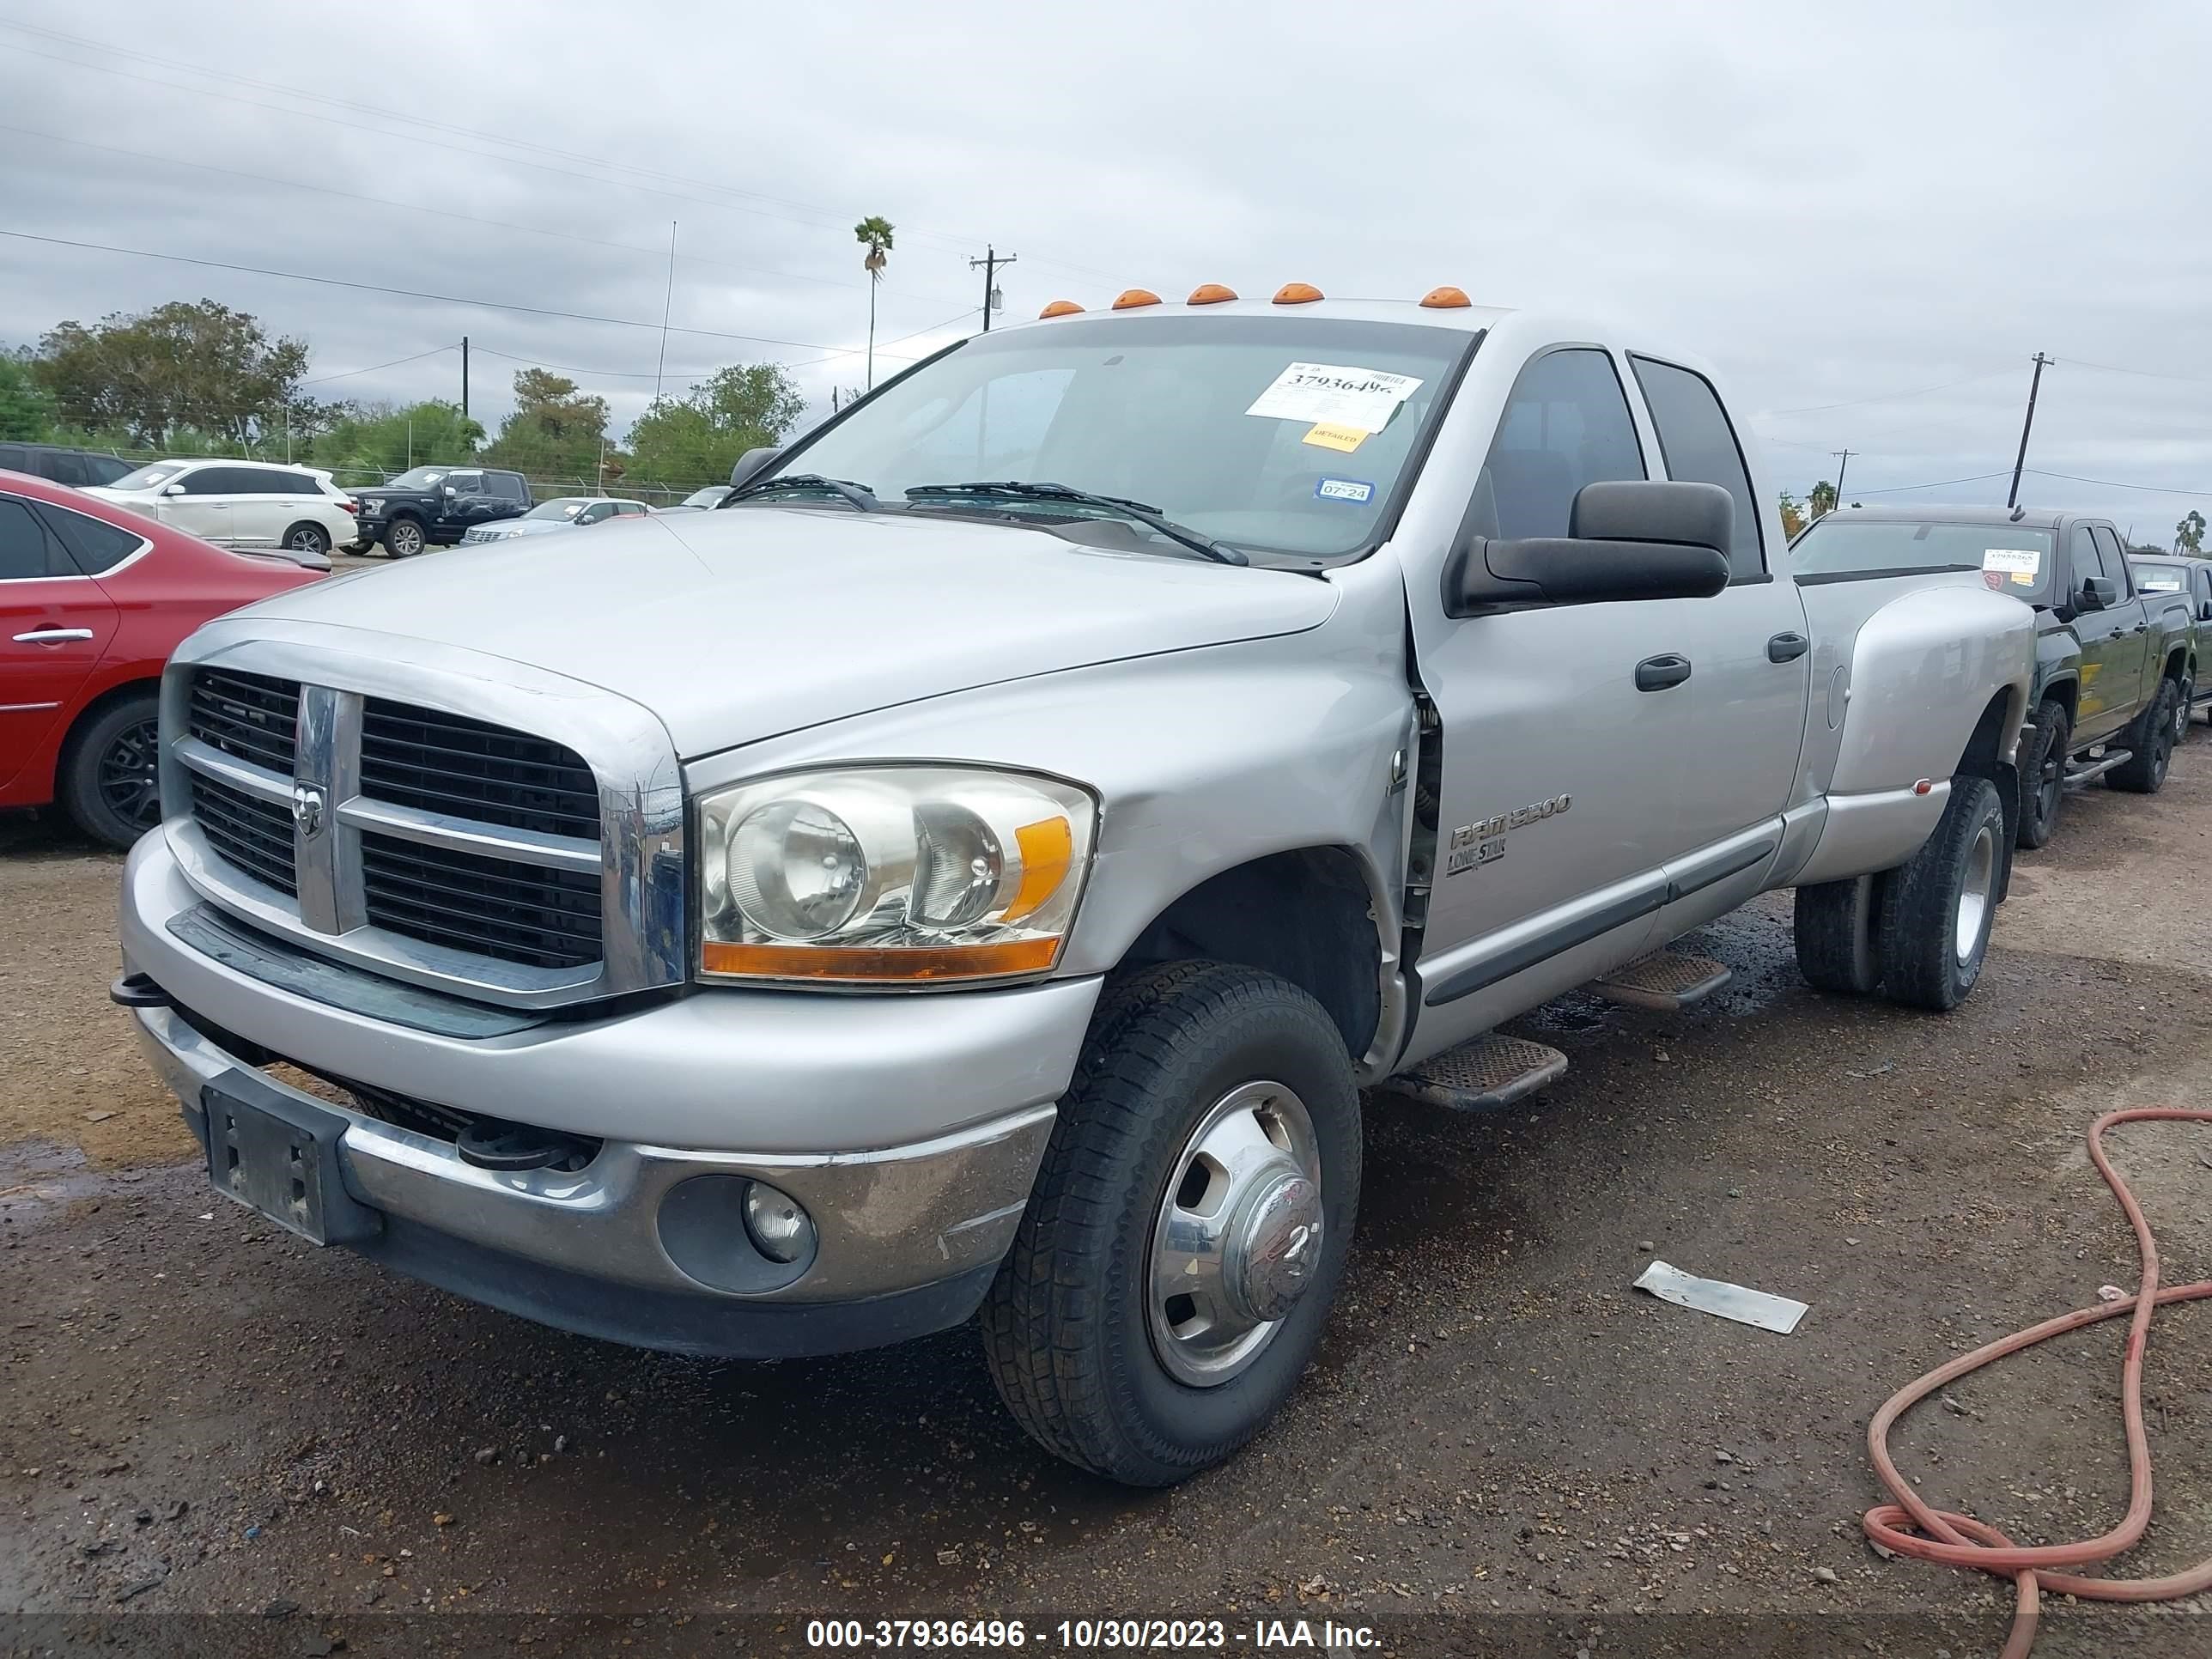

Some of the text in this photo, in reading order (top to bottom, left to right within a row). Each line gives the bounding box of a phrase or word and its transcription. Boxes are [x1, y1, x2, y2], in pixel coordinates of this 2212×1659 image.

[1287, 374, 1395, 394] 37936496
[1314, 429, 1358, 443] DETAILED
[1450, 792, 1573, 850] RAM 3500
[1447, 838, 1507, 872] LONE STAR
